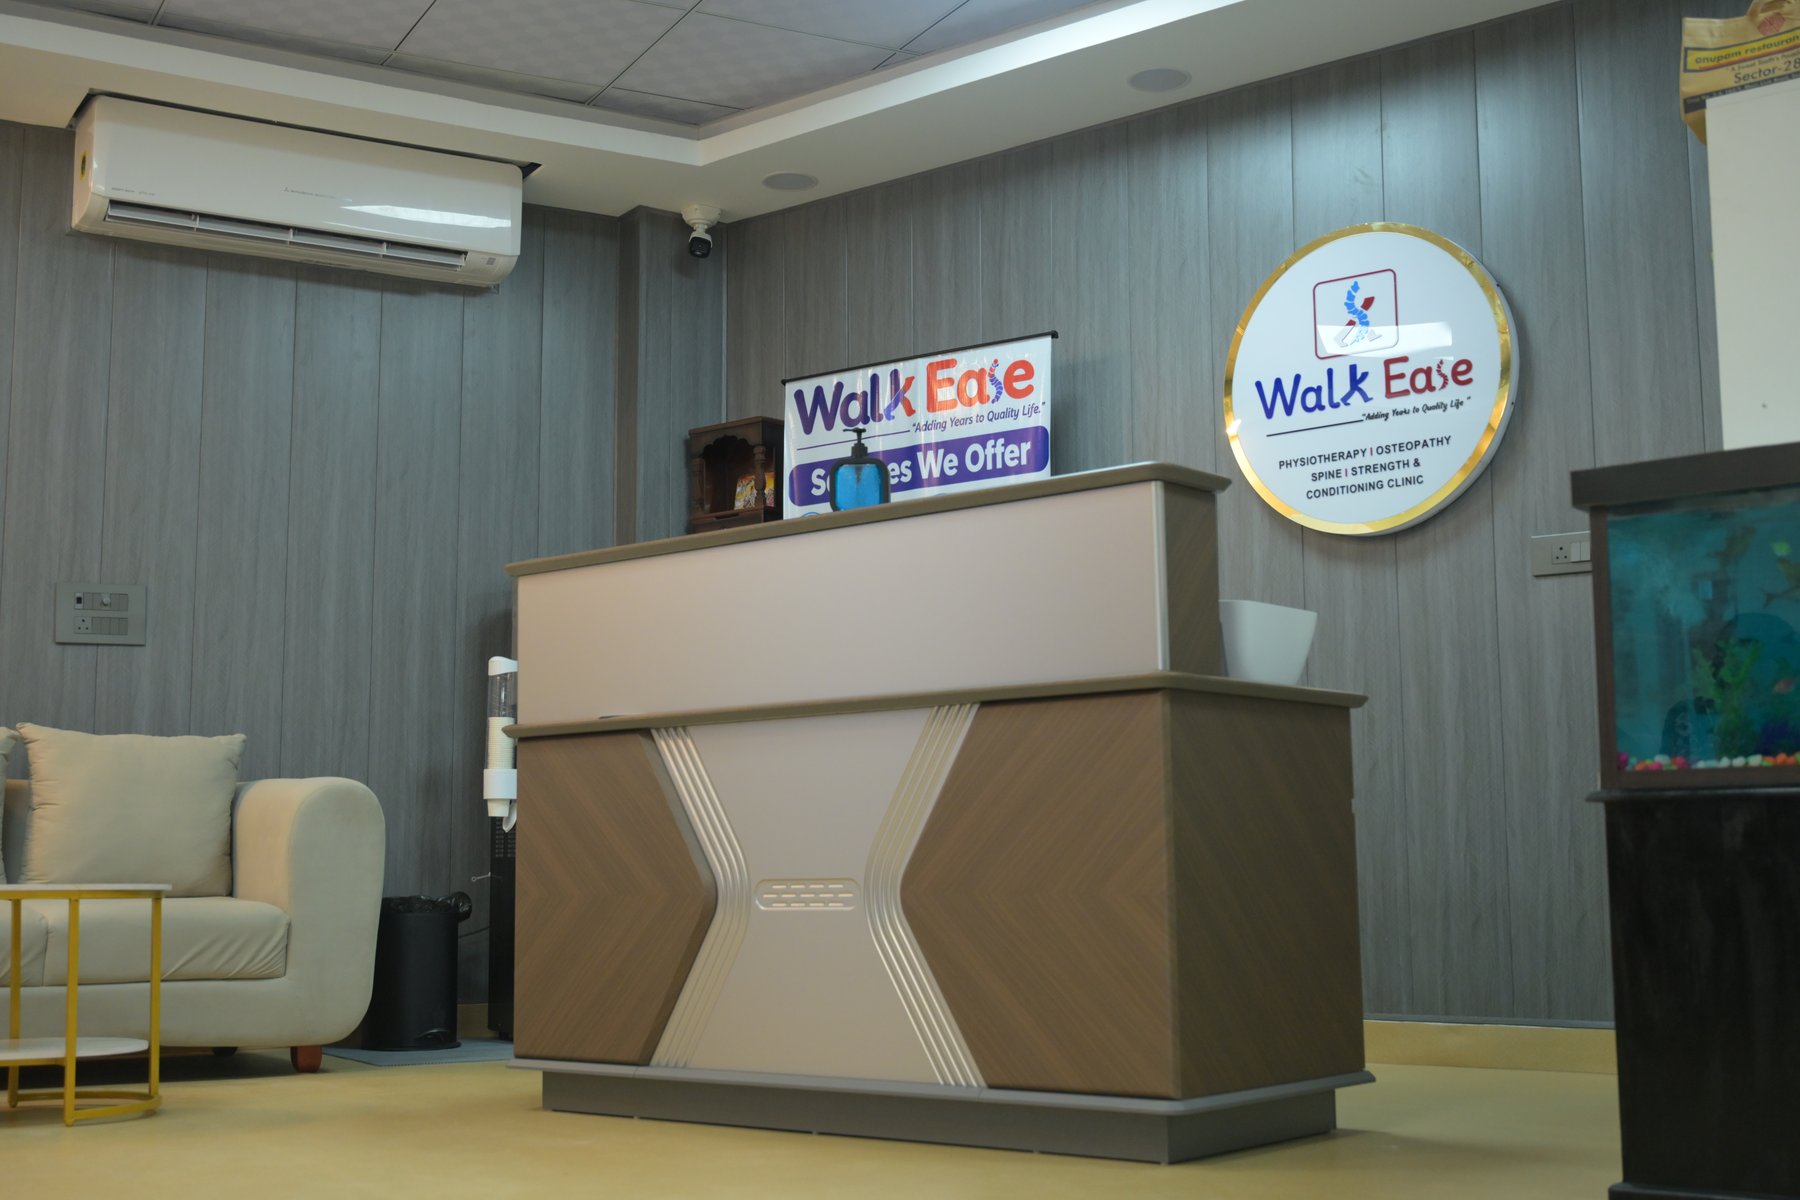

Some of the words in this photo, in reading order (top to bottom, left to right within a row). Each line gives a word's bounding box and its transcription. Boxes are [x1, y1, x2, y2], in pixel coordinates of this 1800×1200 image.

[794, 368, 916, 435] Walk
[926, 358, 1035, 413] Ease
[1255, 364, 1373, 420] Walk
[1383, 356, 1473, 399] Ease
[949, 416, 973, 428] Years
[975, 413, 985, 424] to
[987, 407, 1019, 421] Quality
[1412, 406, 1420, 414] to
[1422, 402, 1448, 413] Quality
[917, 448, 959, 480] We
[965, 438, 1031, 473] Offer
[1278, 447, 1367, 470] PHYSIOTHERAPY
[1375, 435, 1452, 456] OSTEOPATHY
[1311, 468, 1342, 482] SPINE
[1351, 458, 1410, 477] STRENGTH
[1413, 458, 1421, 468] &
[1306, 480, 1384, 499] CONDITIONING
[1387, 475, 1424, 489] CLINIC
